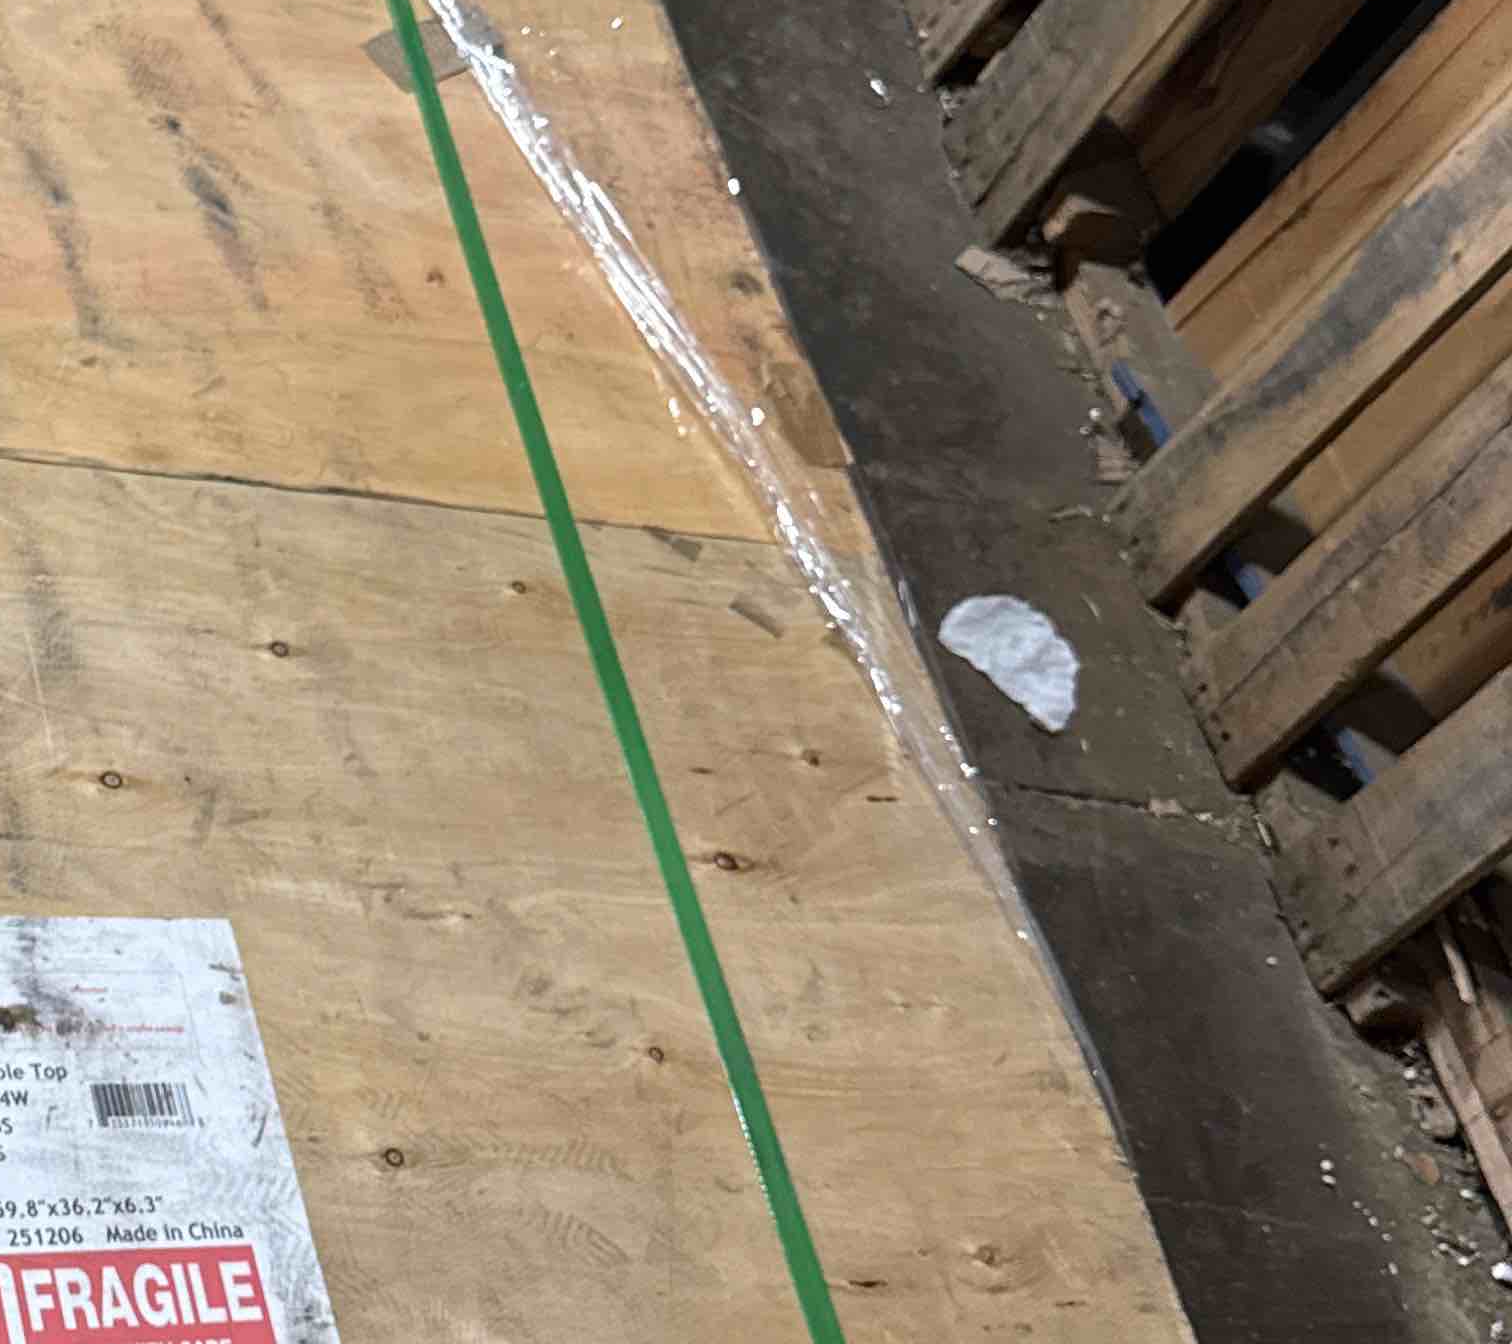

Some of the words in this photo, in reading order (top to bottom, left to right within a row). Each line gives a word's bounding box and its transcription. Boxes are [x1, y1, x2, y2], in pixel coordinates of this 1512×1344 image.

[29, 1063, 68, 1083] Top
[7, 1227, 85, 1248] 251206
[105, 1224, 158, 1244] Made
[163, 1223, 183, 1241] in
[188, 1221, 245, 1241] China
[19, 1260, 264, 1333] FRAGILE
